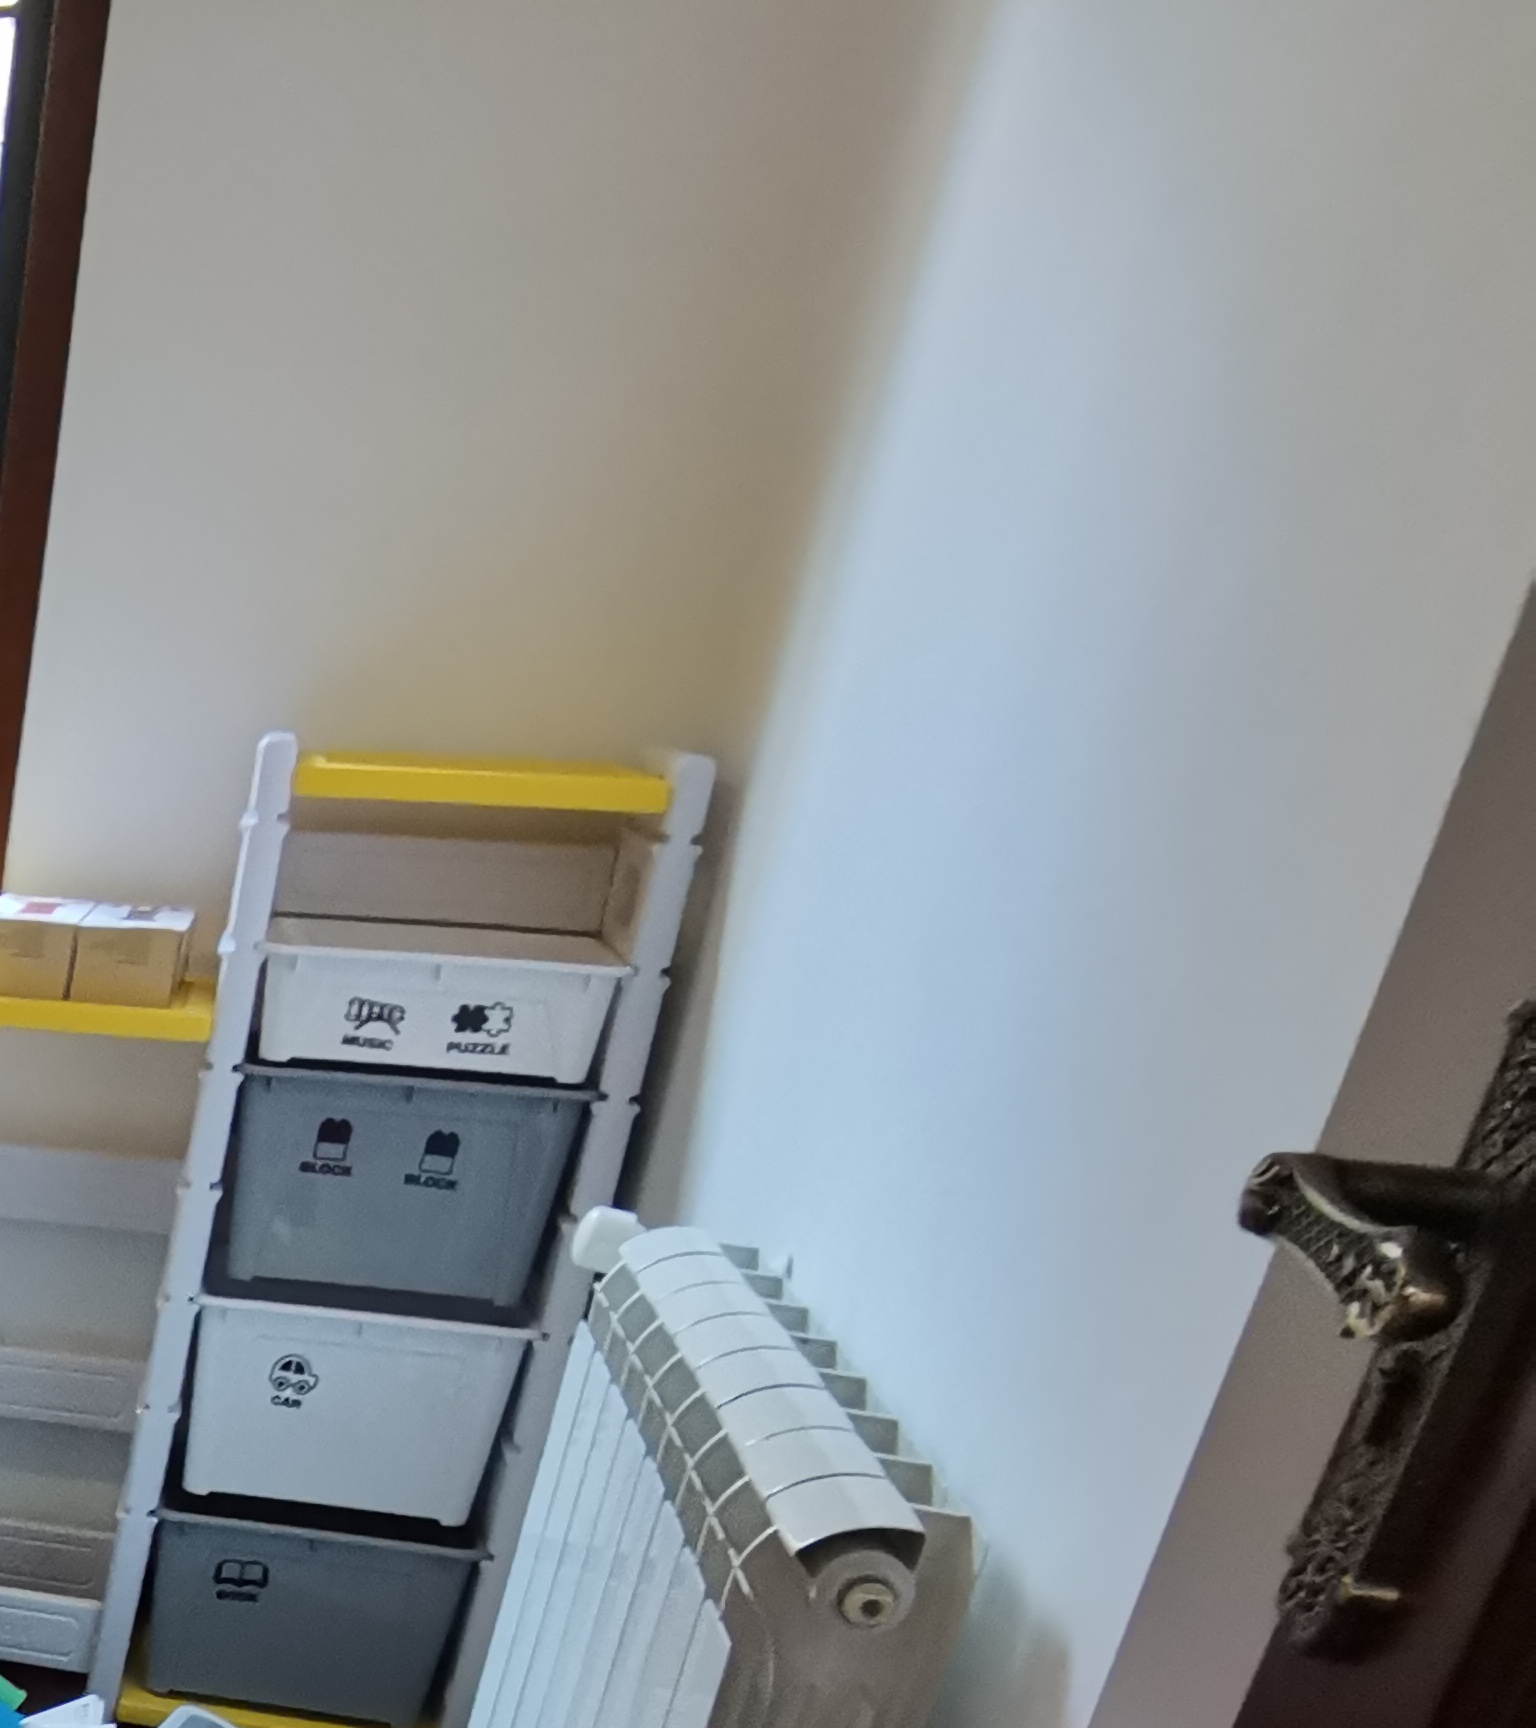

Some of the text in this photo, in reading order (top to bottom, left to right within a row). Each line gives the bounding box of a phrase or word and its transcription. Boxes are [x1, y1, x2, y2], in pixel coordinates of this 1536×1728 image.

[446, 1041, 511, 1055] PUZZLE
[299, 1161, 353, 1177] BLOCK
[404, 1173, 458, 1191] BLOCK
[270, 1395, 303, 1409] CAR
